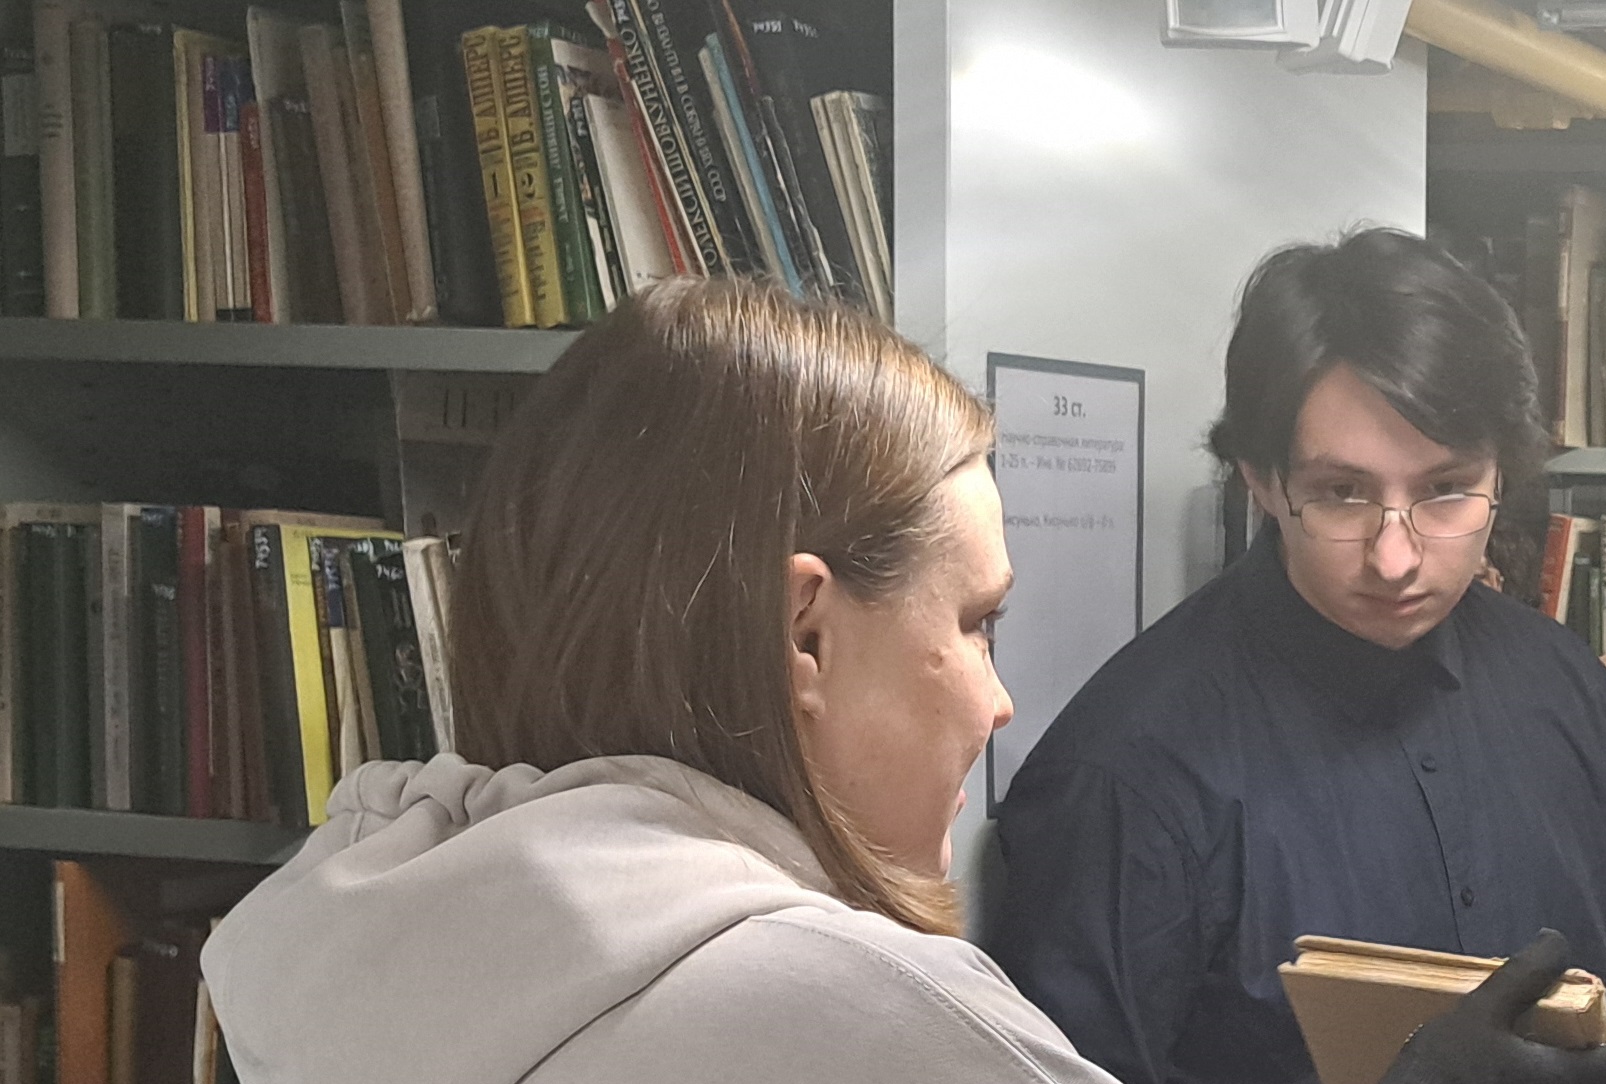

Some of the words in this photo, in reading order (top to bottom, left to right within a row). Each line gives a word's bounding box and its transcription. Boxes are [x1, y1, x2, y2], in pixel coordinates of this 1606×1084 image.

[465, 33, 497, 119] АЛПЕРС
[501, 34, 533, 119] АЛПЕРС
[1053, 395, 1068, 416] 33
